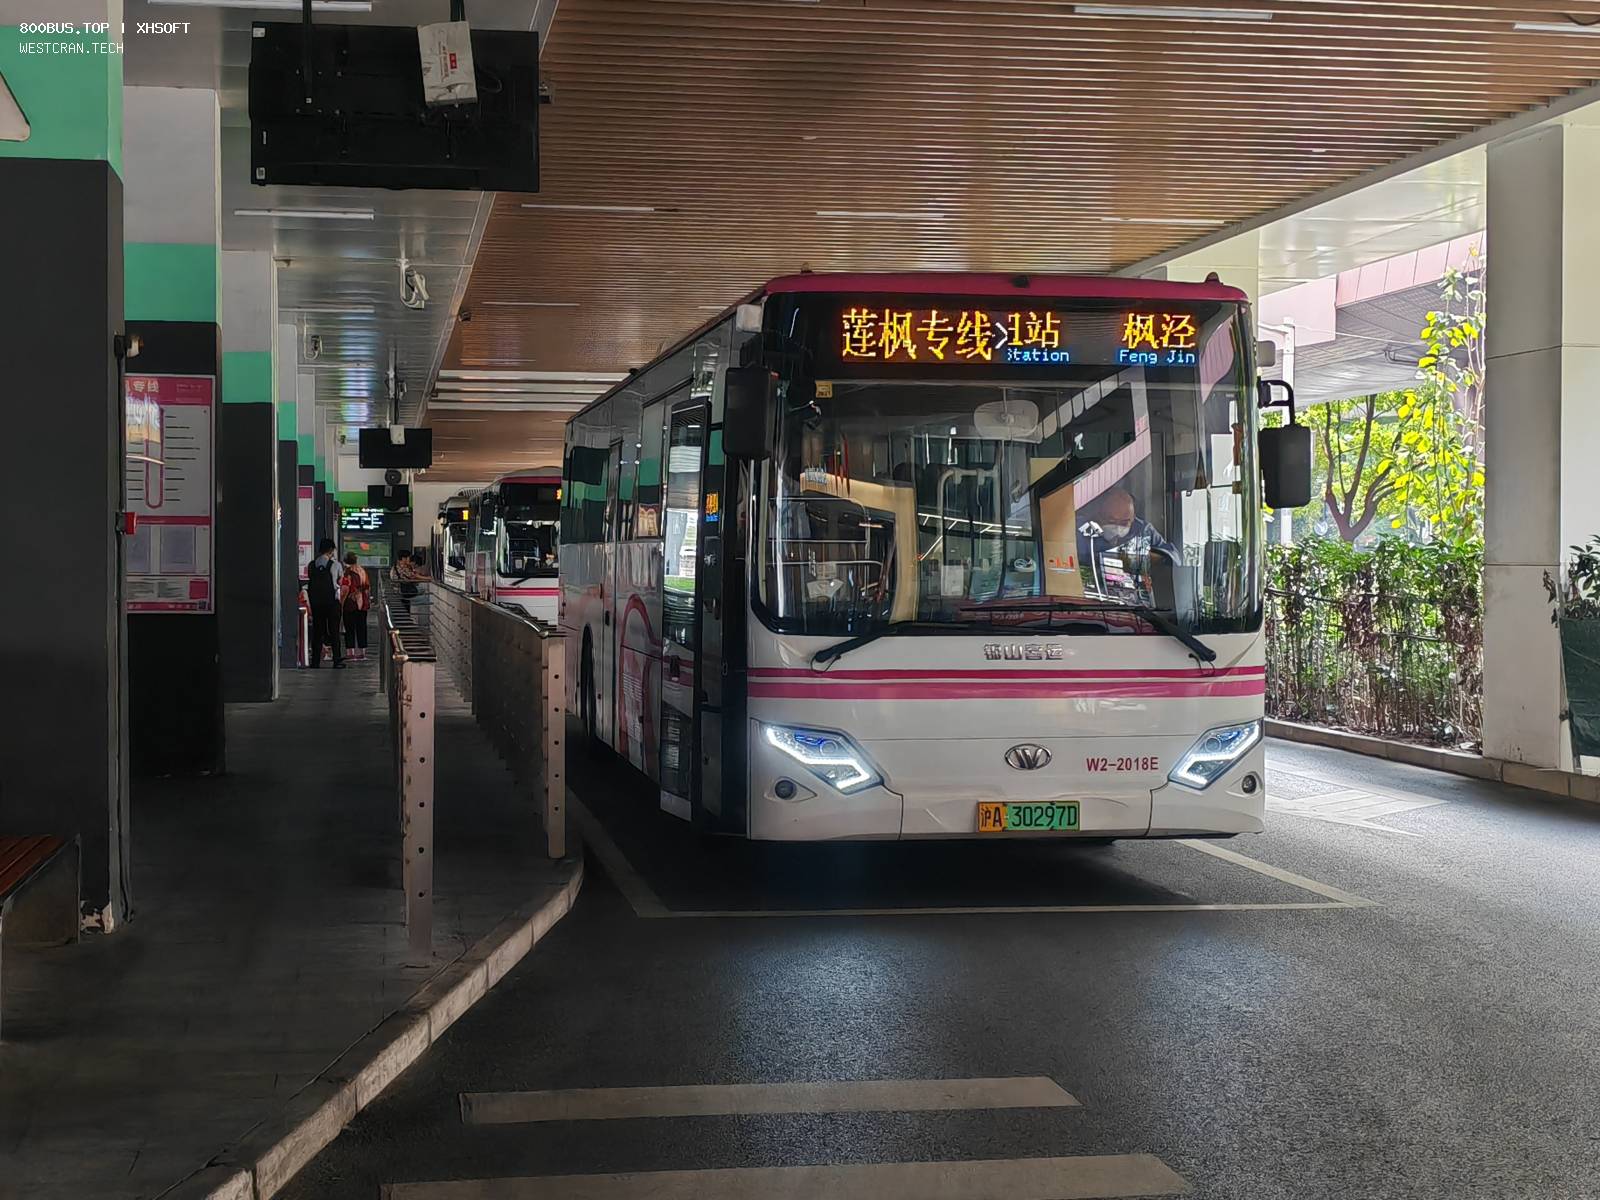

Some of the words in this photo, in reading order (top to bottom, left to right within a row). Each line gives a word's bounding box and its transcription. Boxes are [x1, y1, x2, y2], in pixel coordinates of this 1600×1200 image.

[842, 307, 995, 361] 莲枫专线
[1121, 312, 1197, 349] 枫泾
[1119, 349, 1158, 364] Feng
[1166, 349, 1196, 364] Jin
[1086, 757, 1159, 772] W2-2018E
